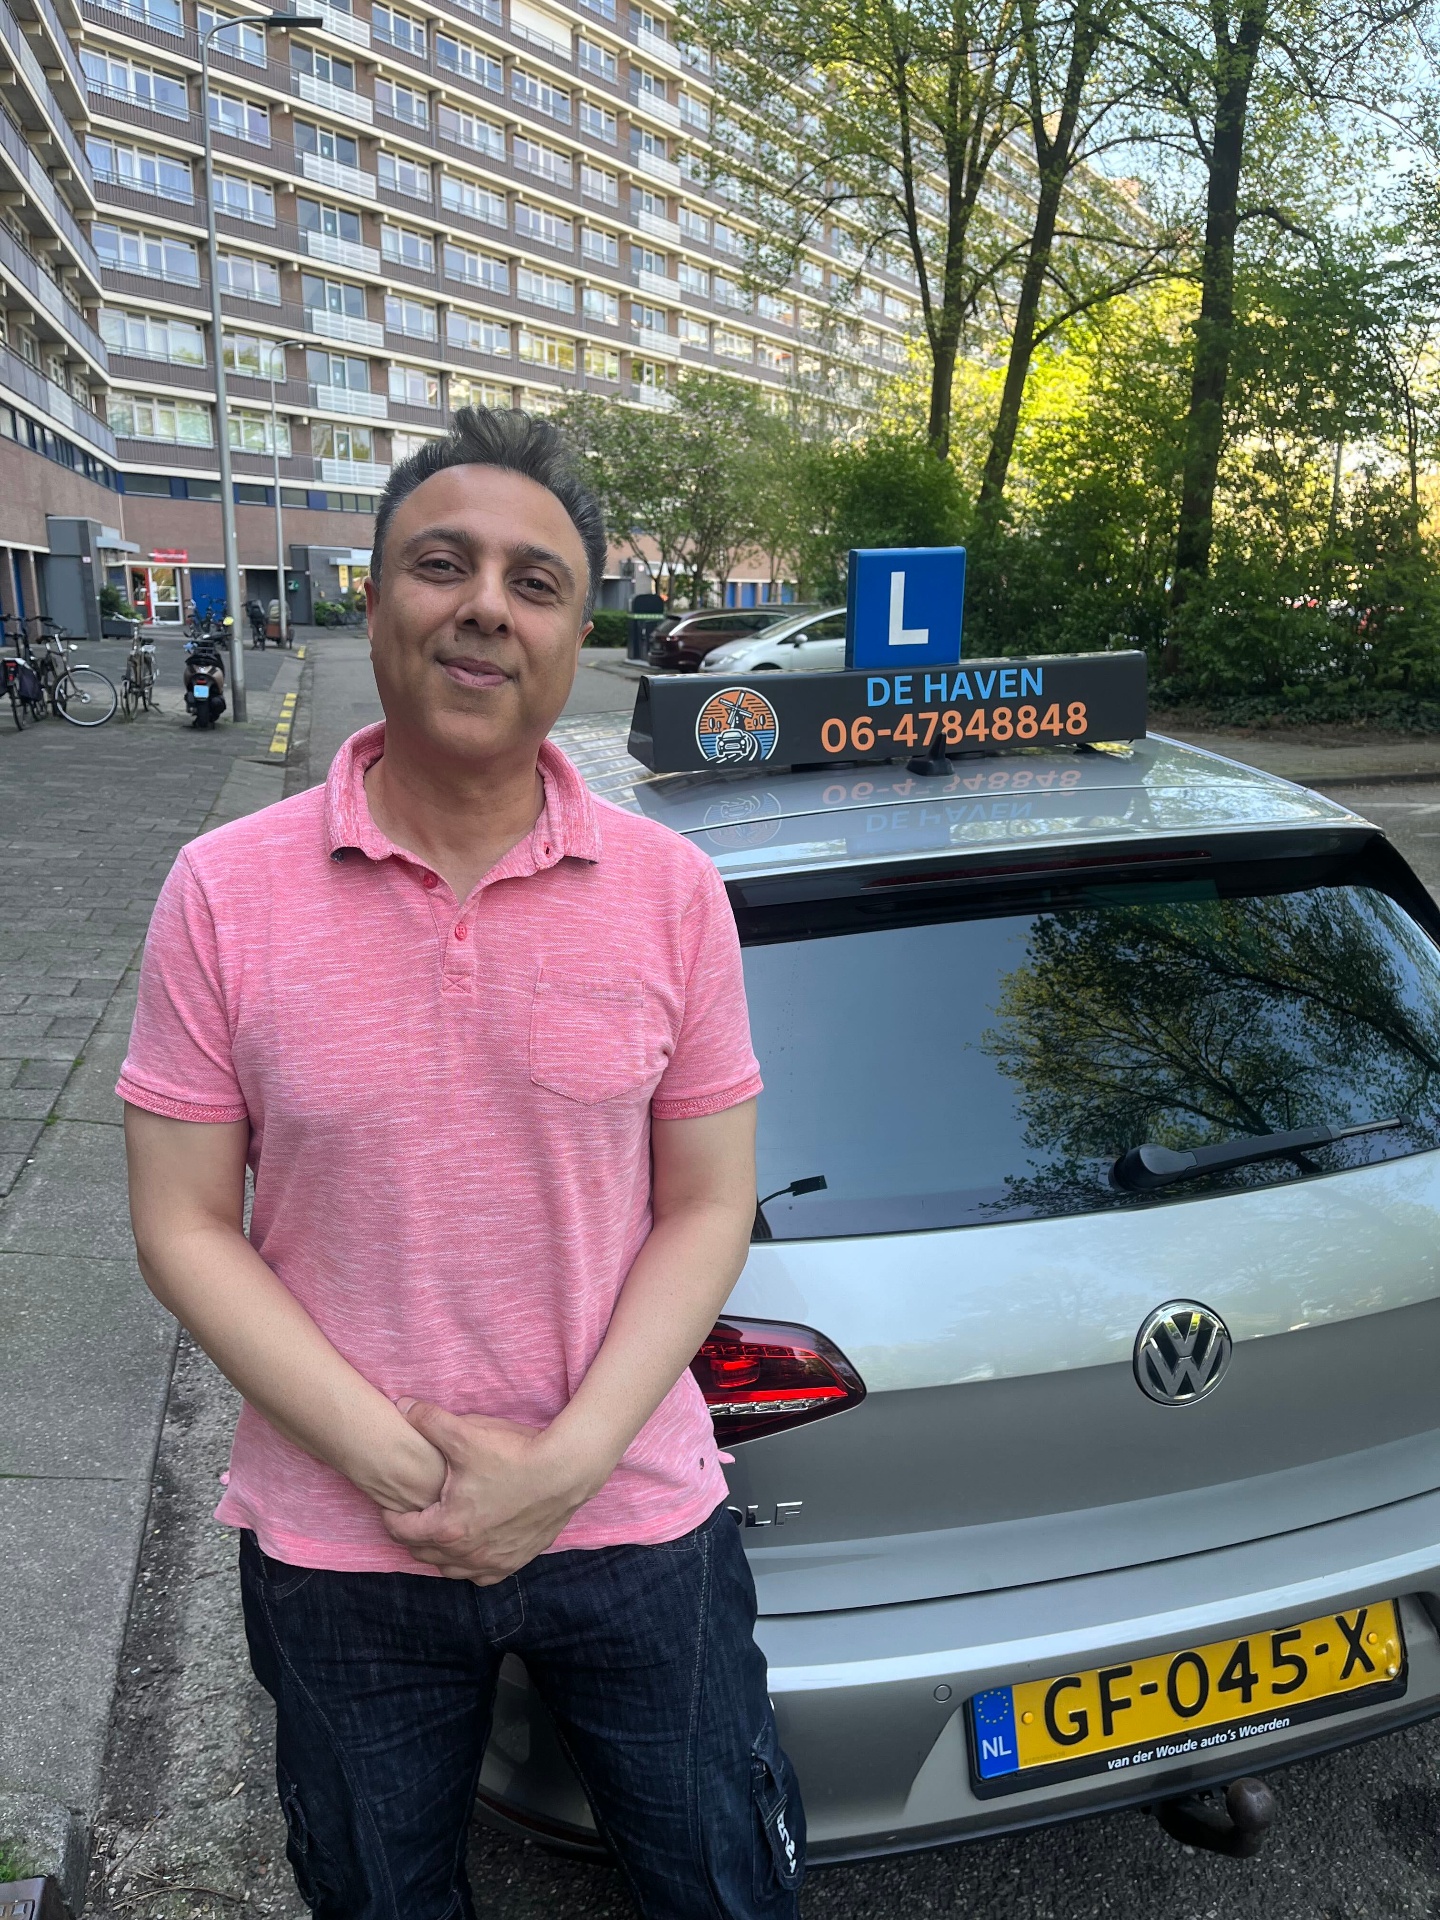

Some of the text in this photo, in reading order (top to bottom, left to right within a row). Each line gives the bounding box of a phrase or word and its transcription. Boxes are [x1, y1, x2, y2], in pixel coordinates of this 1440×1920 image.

[888, 571, 929, 646] L
[867, 667, 1043, 707] DE HAVEN
[821, 701, 1088, 753] 06-47848848
[1137, 1306, 1226, 1401] VW
[1043, 1608, 1376, 1746] GF-045-X
[982, 1735, 1012, 1760] NL
[1107, 1717, 1290, 1770] van der Woude auto's Woerden
